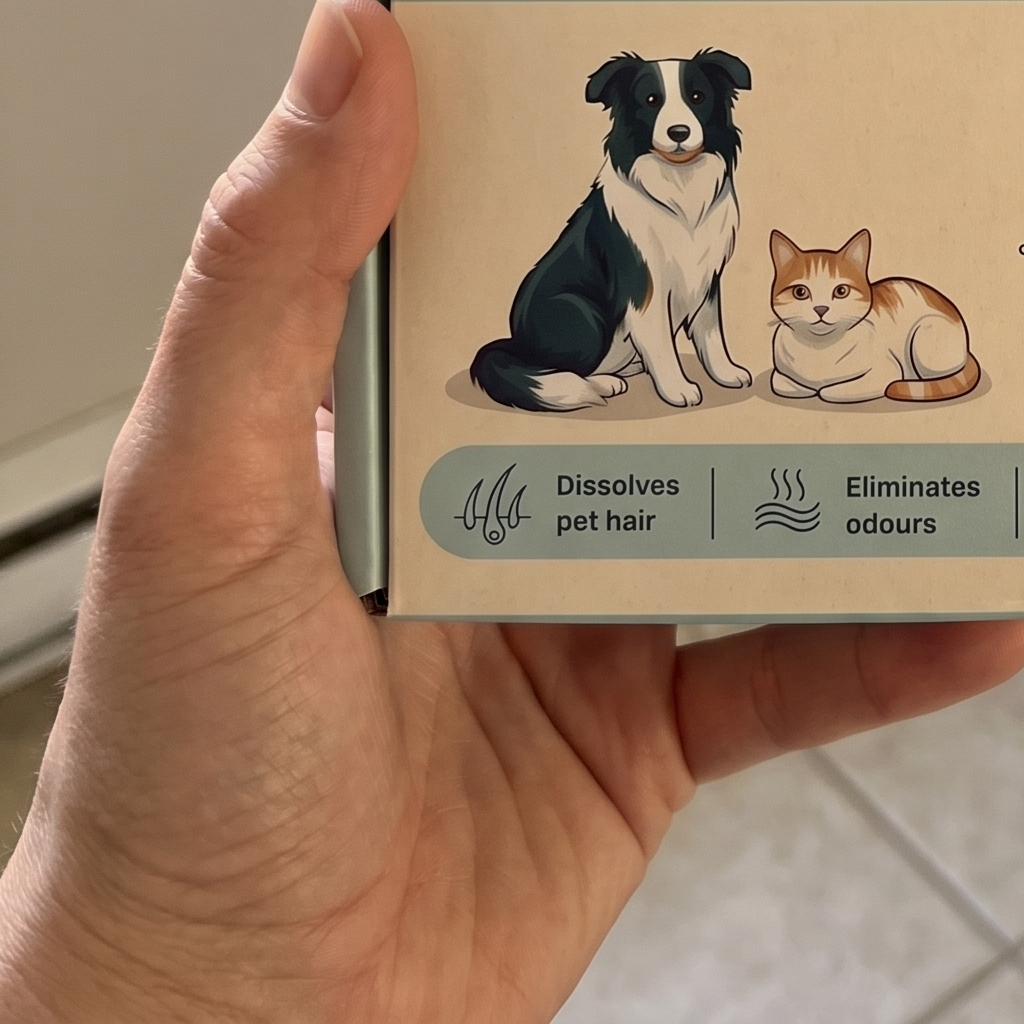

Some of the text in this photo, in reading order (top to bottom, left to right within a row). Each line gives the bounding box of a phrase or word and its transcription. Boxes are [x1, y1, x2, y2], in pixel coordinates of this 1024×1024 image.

[557, 473, 680, 496] Dissolves
[846, 475, 981, 498] Eliminates
[557, 508, 657, 537] pet hair
[846, 512, 937, 535] odours
